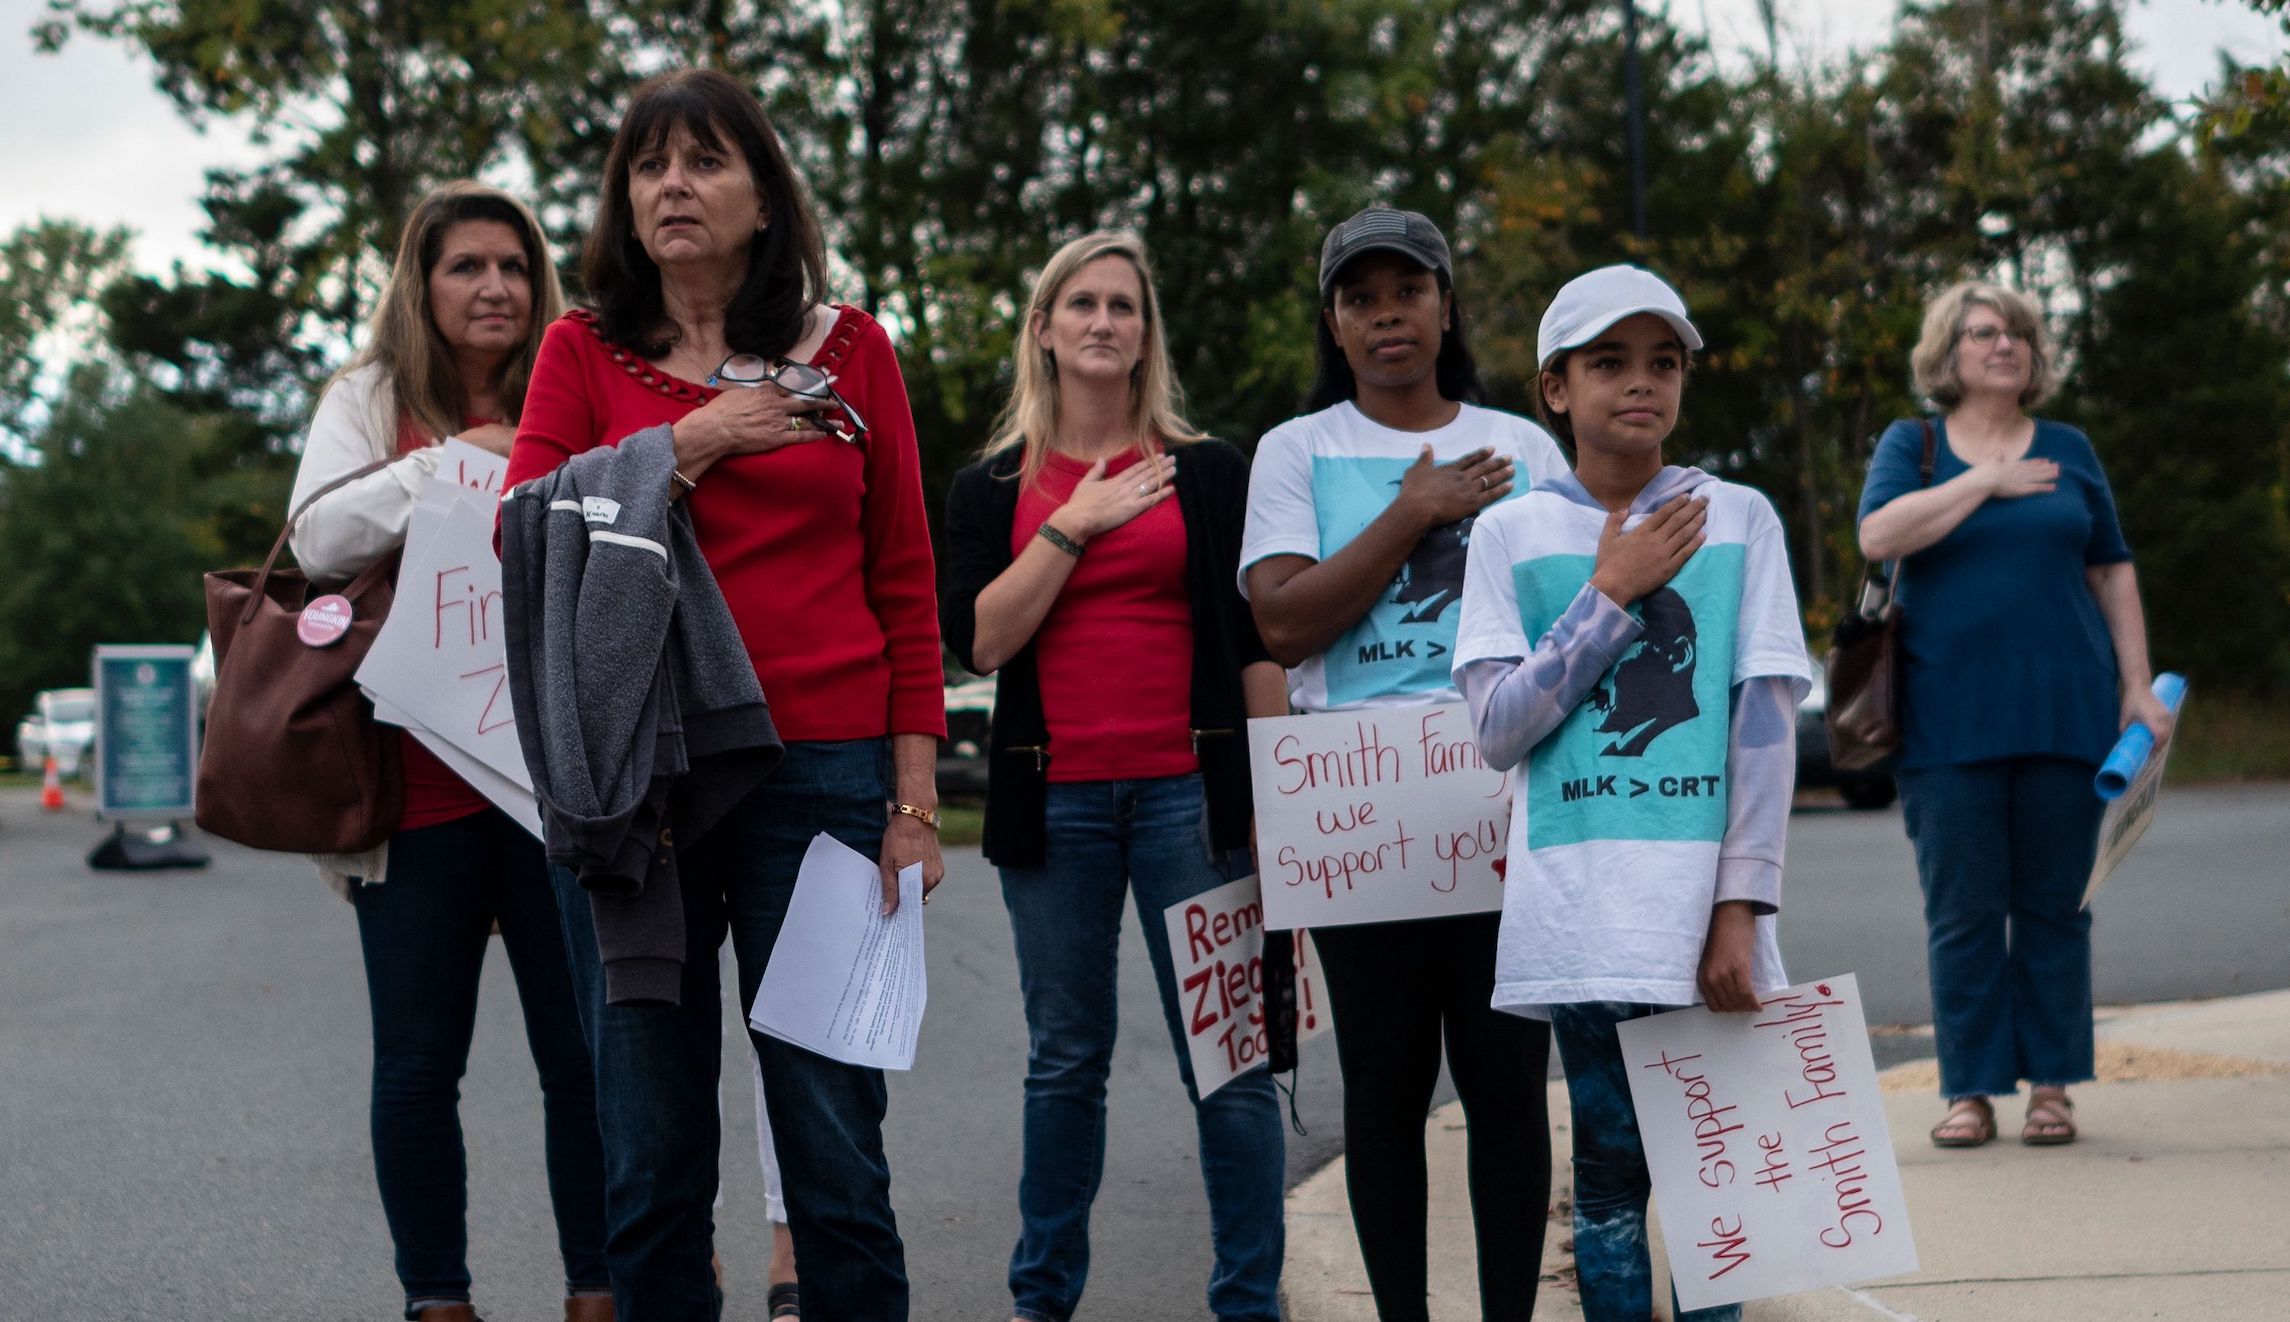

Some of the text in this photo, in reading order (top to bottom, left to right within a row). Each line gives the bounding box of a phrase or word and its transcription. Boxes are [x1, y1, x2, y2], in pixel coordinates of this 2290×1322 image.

[303, 608, 350, 629] YOUNGKIN
[435, 566, 502, 648] Fir
[1358, 640, 1447, 664] MLK >
[460, 663, 516, 736] Z
[1275, 721, 1399, 794] Smith
[1561, 775, 1720, 802] MLK > CRT
[1185, 903, 1264, 964] Rem
[1754, 1131, 1793, 1194] the
[1808, 1121, 1882, 1249] Smith
[1697, 1212, 1751, 1281] We
